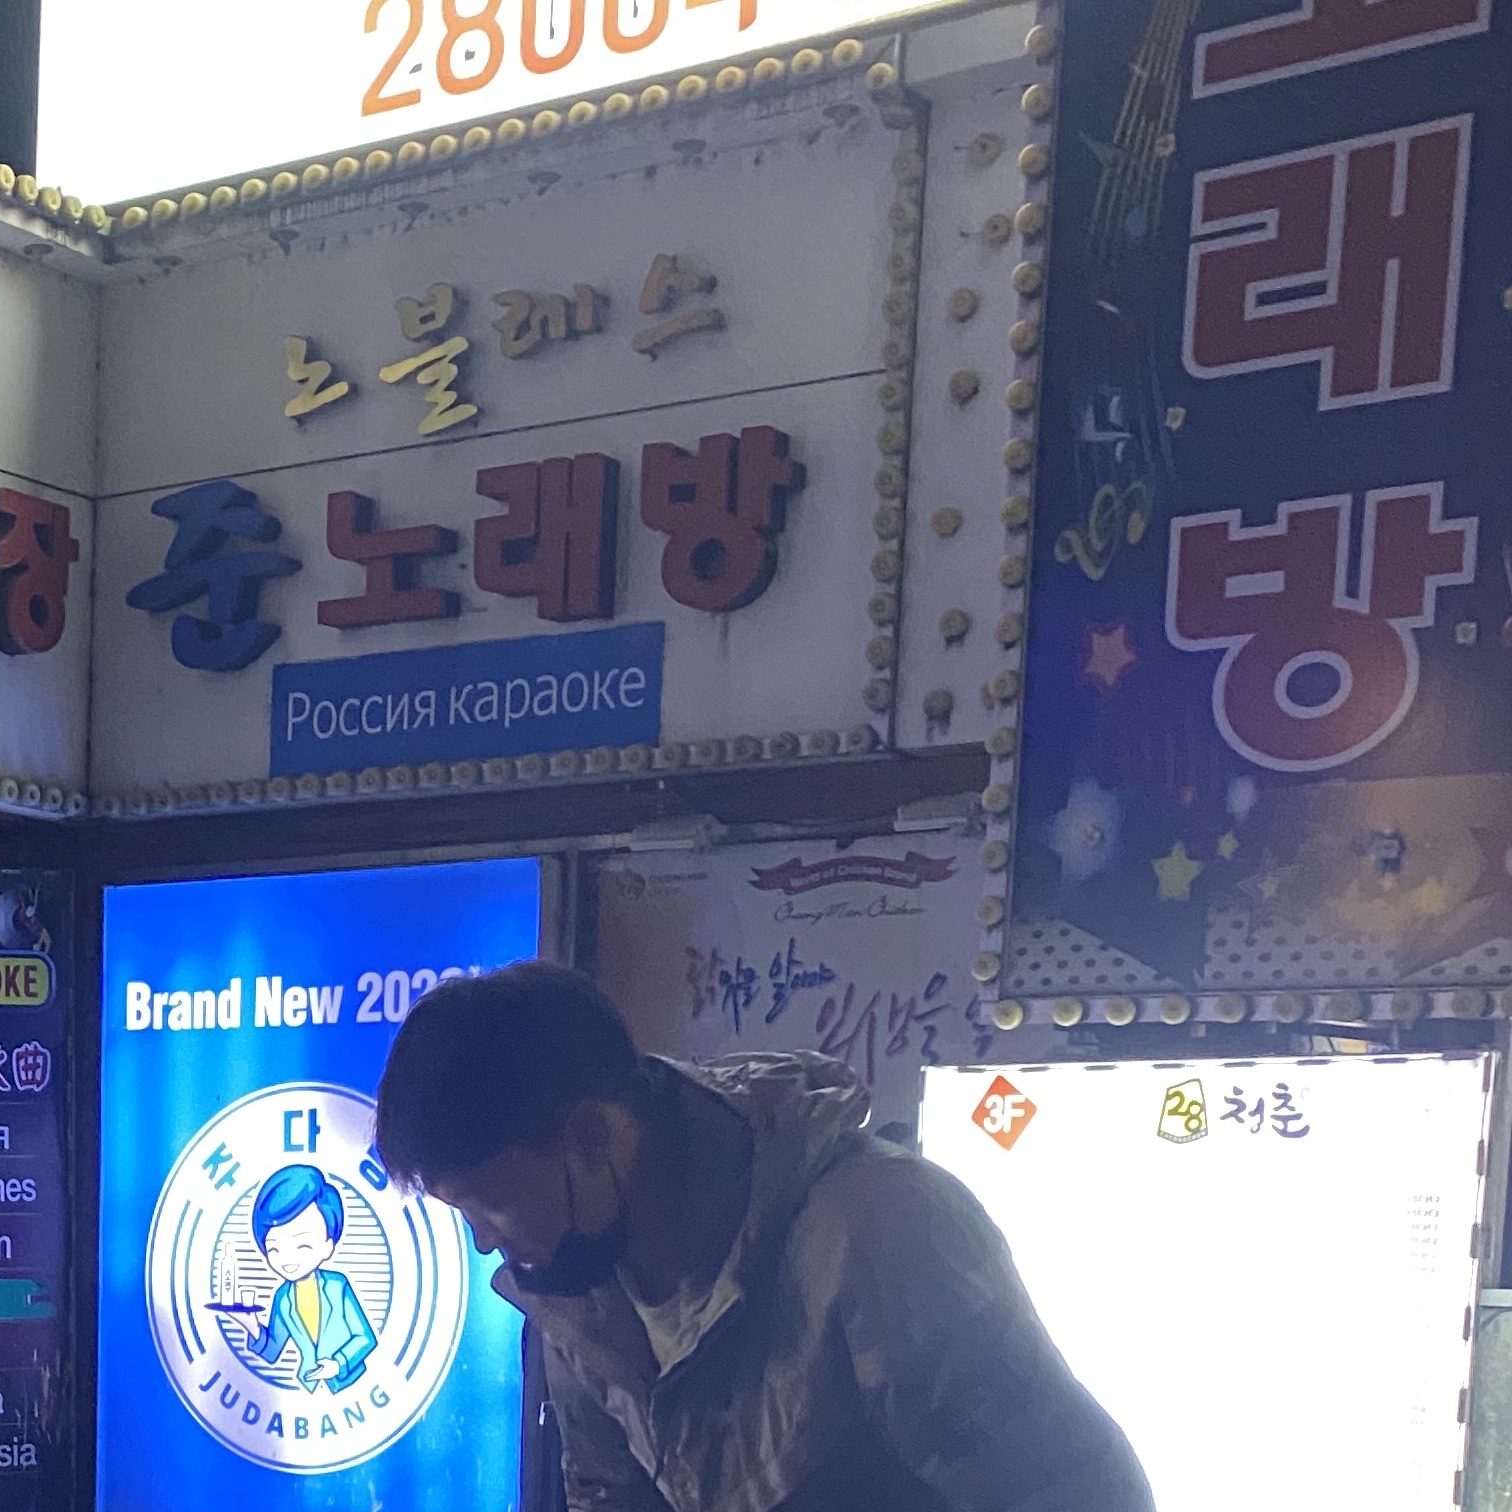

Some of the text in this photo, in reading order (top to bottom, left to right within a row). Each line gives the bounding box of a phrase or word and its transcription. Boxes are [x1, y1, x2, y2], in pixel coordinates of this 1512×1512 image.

[284, 253, 725, 435] 노블레스
[126, 426, 806, 670] 준 노래방
[288, 662, 646, 741] Россия караоке
[126, 978, 241, 1031] Brand
[254, 976, 344, 1028] New
[983, 1096, 1026, 1134] 3F
[1167, 1090, 1205, 1133] 28
[1220, 1083, 1311, 1138] 청춘
[198, 1368, 391, 1440] JUDABANG
